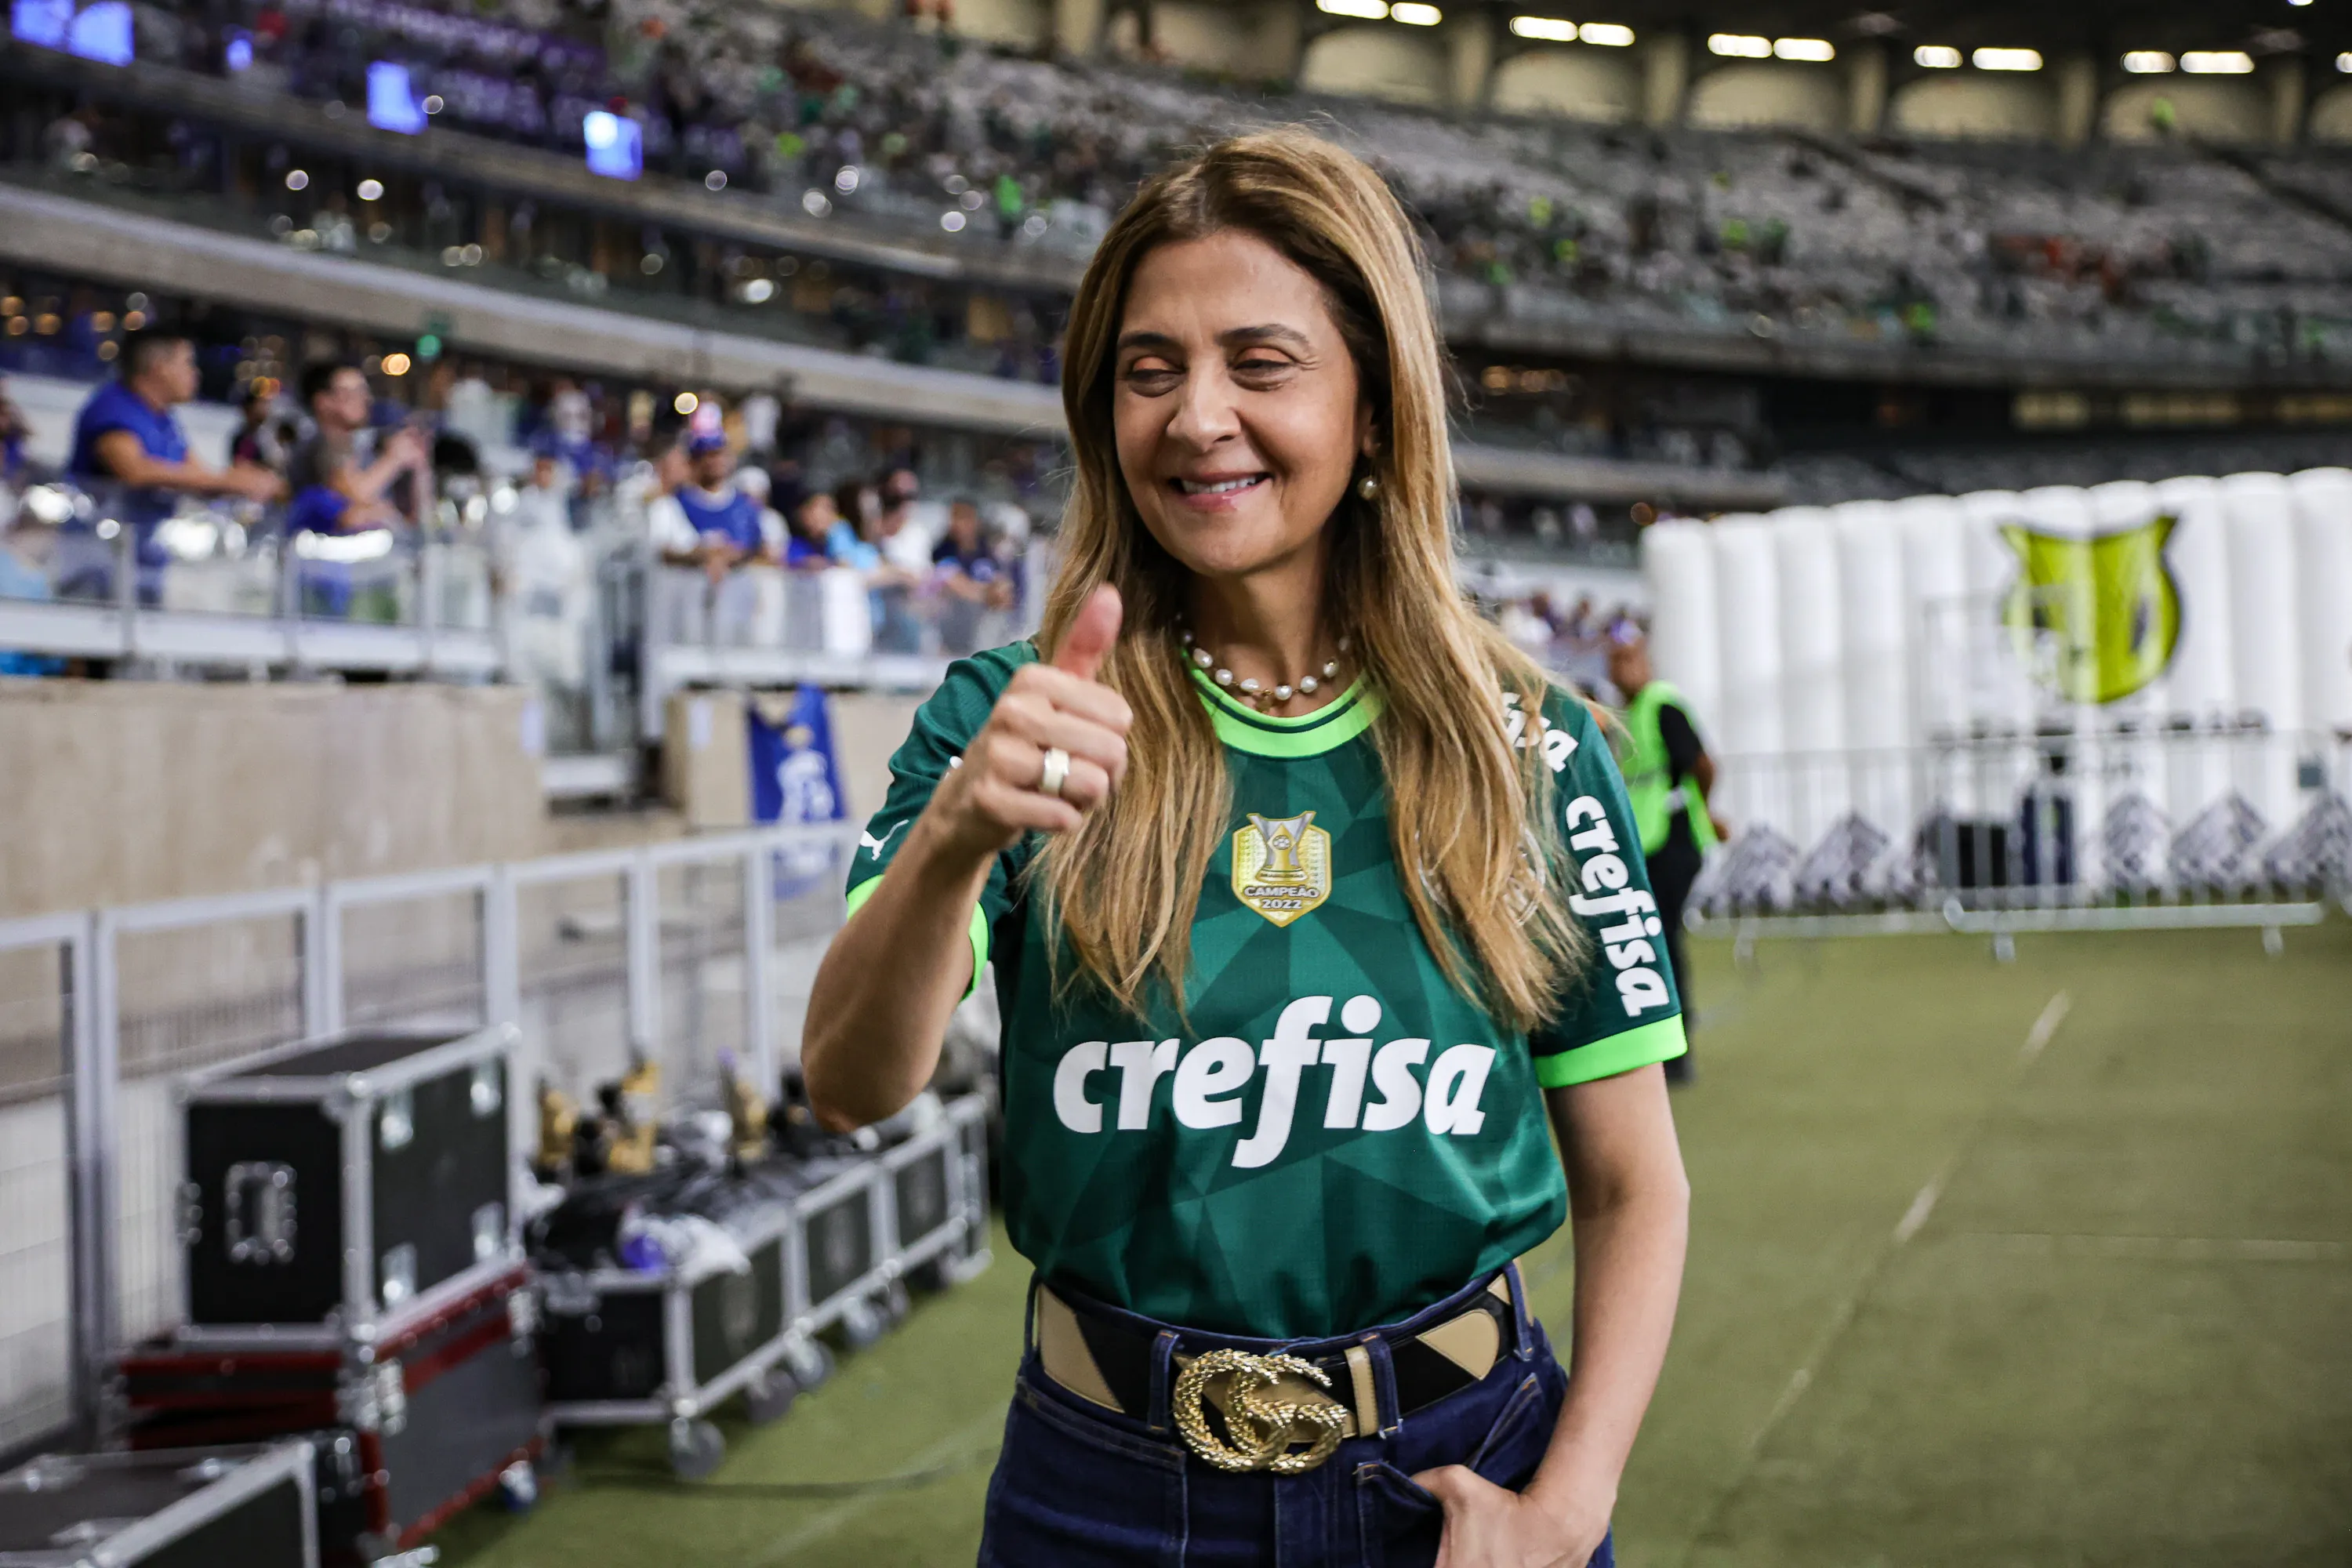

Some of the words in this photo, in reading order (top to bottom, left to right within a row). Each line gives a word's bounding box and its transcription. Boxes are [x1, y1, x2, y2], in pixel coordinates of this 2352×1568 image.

[1244, 884, 1319, 898] CAMPEÃO
[1261, 898, 1302, 909] 2022
[1566, 796, 1670, 1018] crefisa
[1054, 995, 1497, 1168] crefisa
